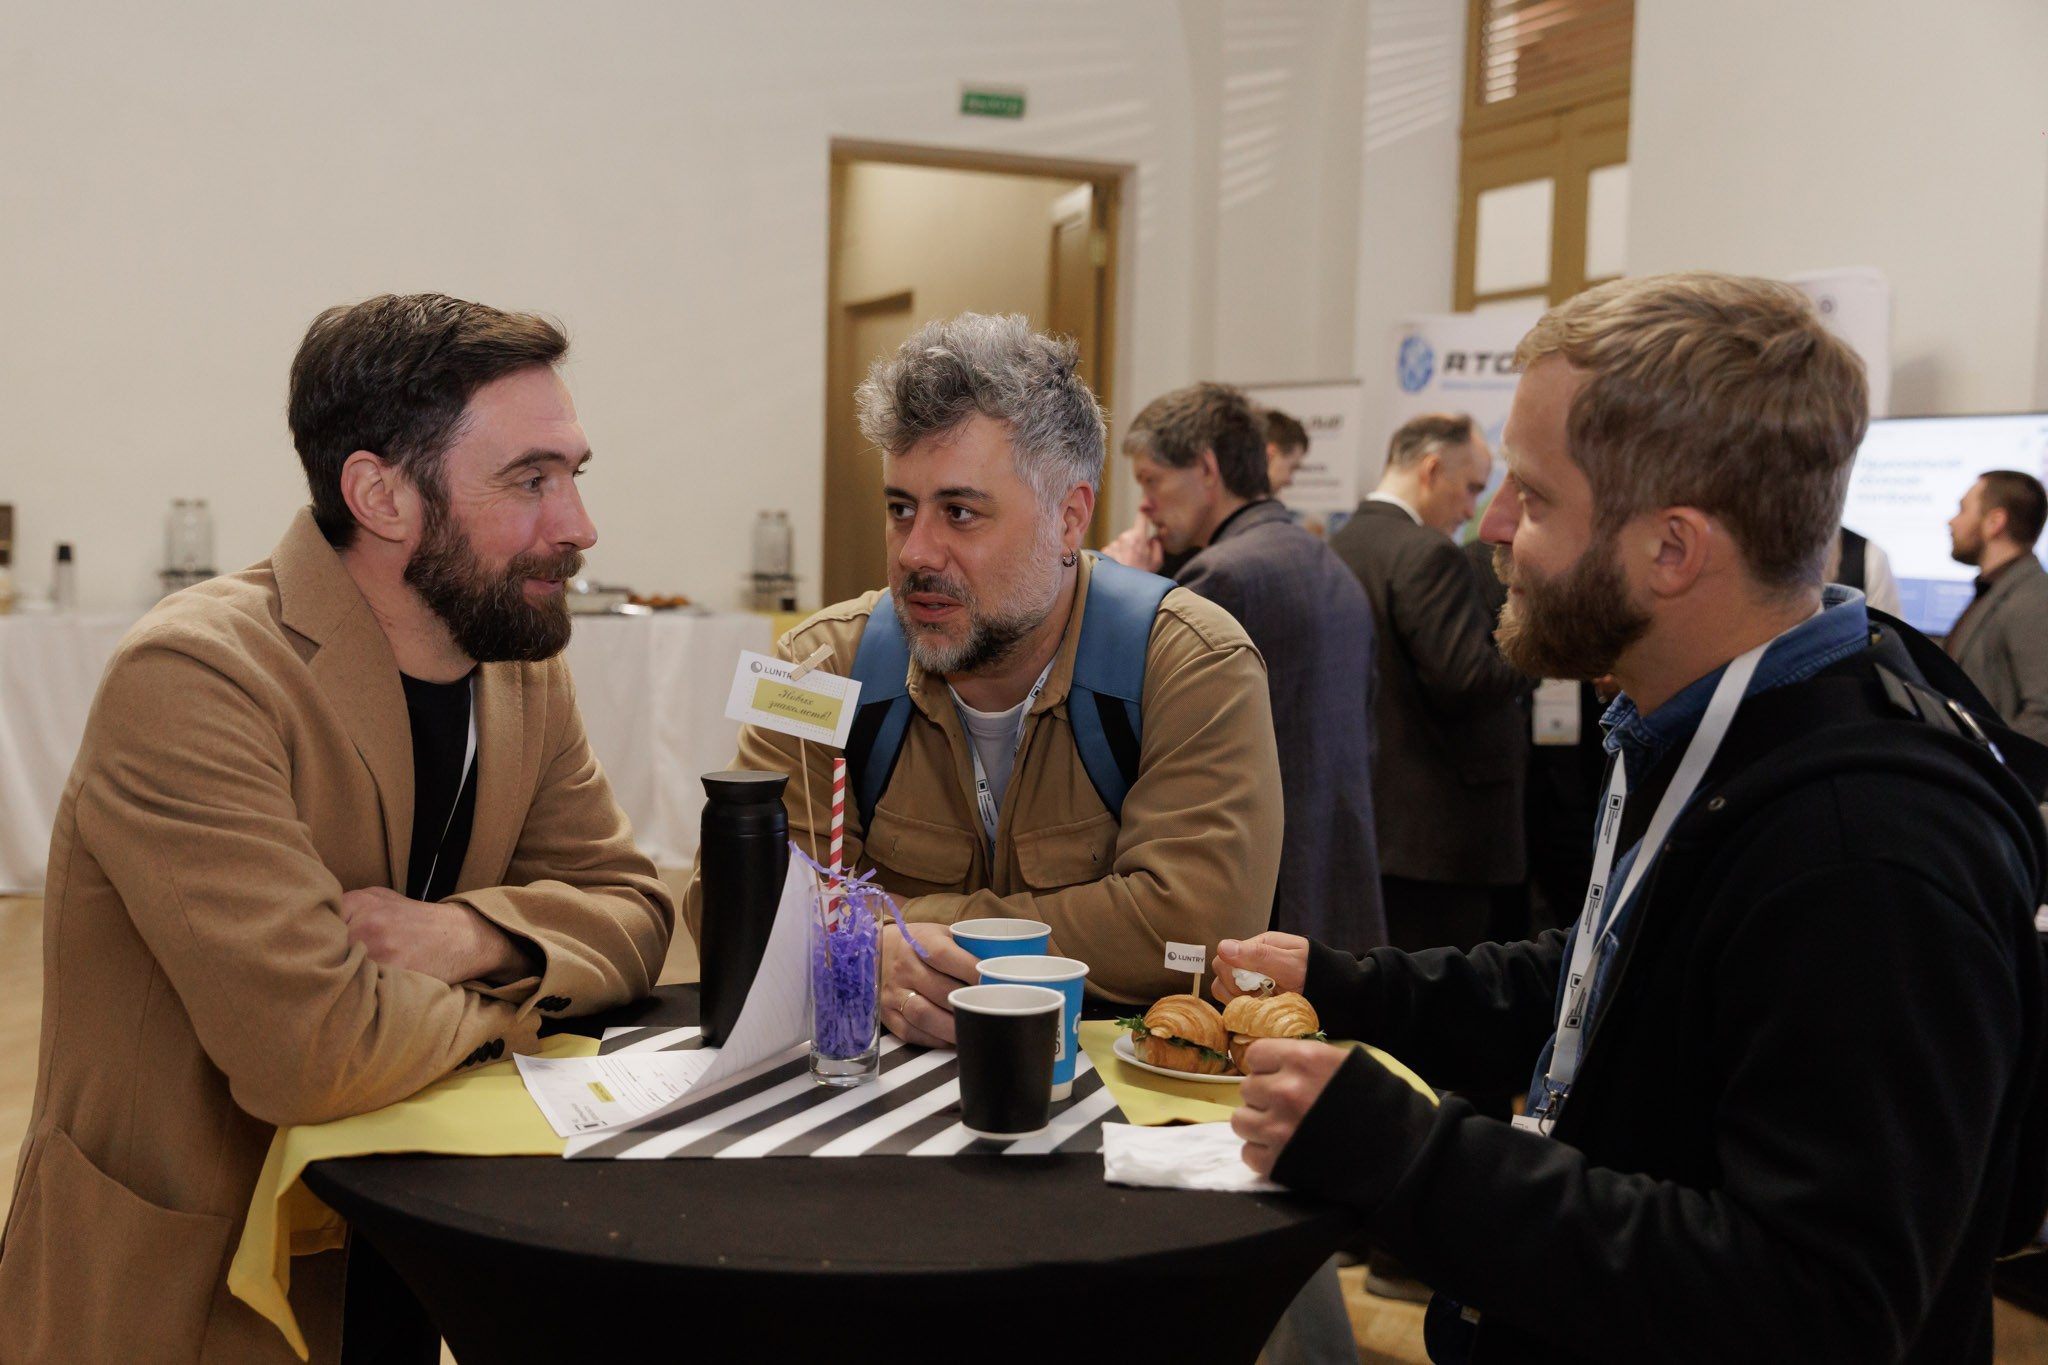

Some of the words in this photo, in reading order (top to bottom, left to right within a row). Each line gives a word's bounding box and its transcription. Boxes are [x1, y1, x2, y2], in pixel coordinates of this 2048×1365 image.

[764, 666, 792, 679] LUNTR
[778, 689, 814, 706] Новых
[1178, 954, 1205, 963] LUNTRY
